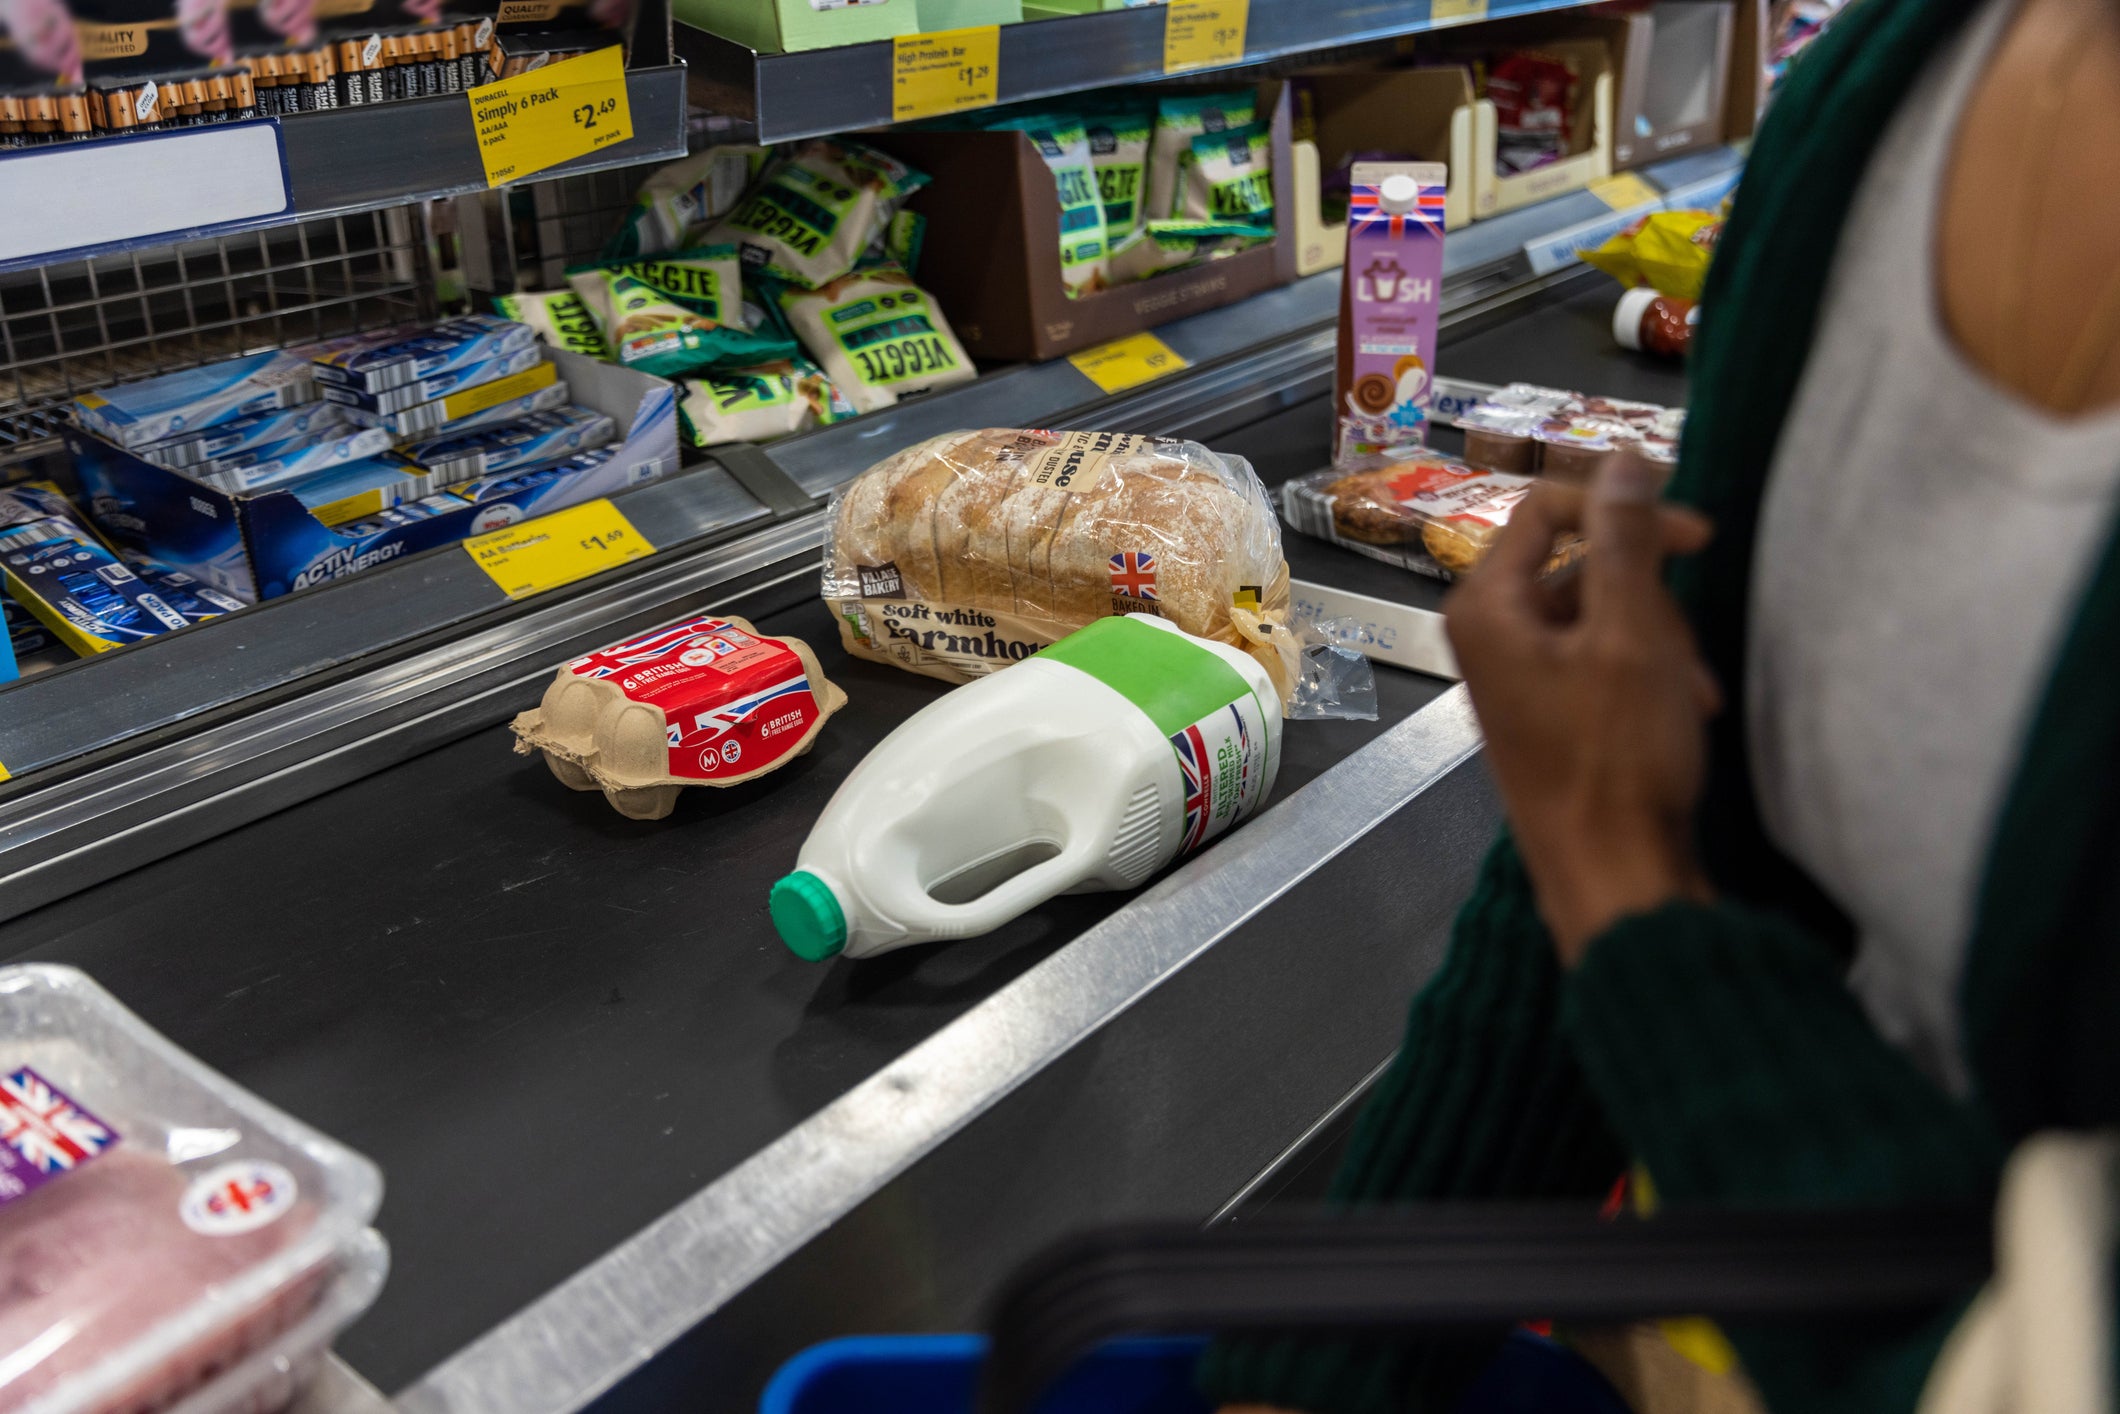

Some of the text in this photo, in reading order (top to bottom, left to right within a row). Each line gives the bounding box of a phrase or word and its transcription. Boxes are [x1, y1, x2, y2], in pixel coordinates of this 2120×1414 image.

[504, 4, 549, 14] QUALITY
[897, 46, 967, 65] High Protein Bar
[474, 89, 509, 105] DURACELL
[477, 88, 559, 122] Simply 6 Pack
[573, 98, 616, 129] £2.49
[481, 121, 509, 136] AA/AAA
[593, 129, 621, 146] per pack
[489, 133, 506, 146] pack
[856, 337, 955, 382] VEGGIE
[1036, 456, 1061, 484] DUSTED
[580, 529, 624, 552] £1.69
[292, 543, 358, 592] ACTIV
[332, 540, 405, 579] ENERGY
[861, 568, 899, 586] VILLAGE
[864, 579, 900, 597] BAKERY
[145, 596, 185, 628] 10 PACK
[883, 603, 996, 628] soft white
[1112, 597, 1160, 615] BAKED IN
[1290, 599, 1398, 650] plase
[633, 662, 685, 681] BRITISH
[641, 675, 659, 685] FREE
[656, 670, 677, 679] RANGE
[623, 678, 637, 690] 6
[769, 709, 802, 729] BRITISH
[771, 717, 804, 736] FREE RANGE EGGS
[761, 723, 769, 737] 6
[1223, 735, 1234, 759] MILK
[703, 752, 717, 768] M
[1215, 747, 1230, 819] FILTERED
[1233, 782, 1241, 799] DAY
